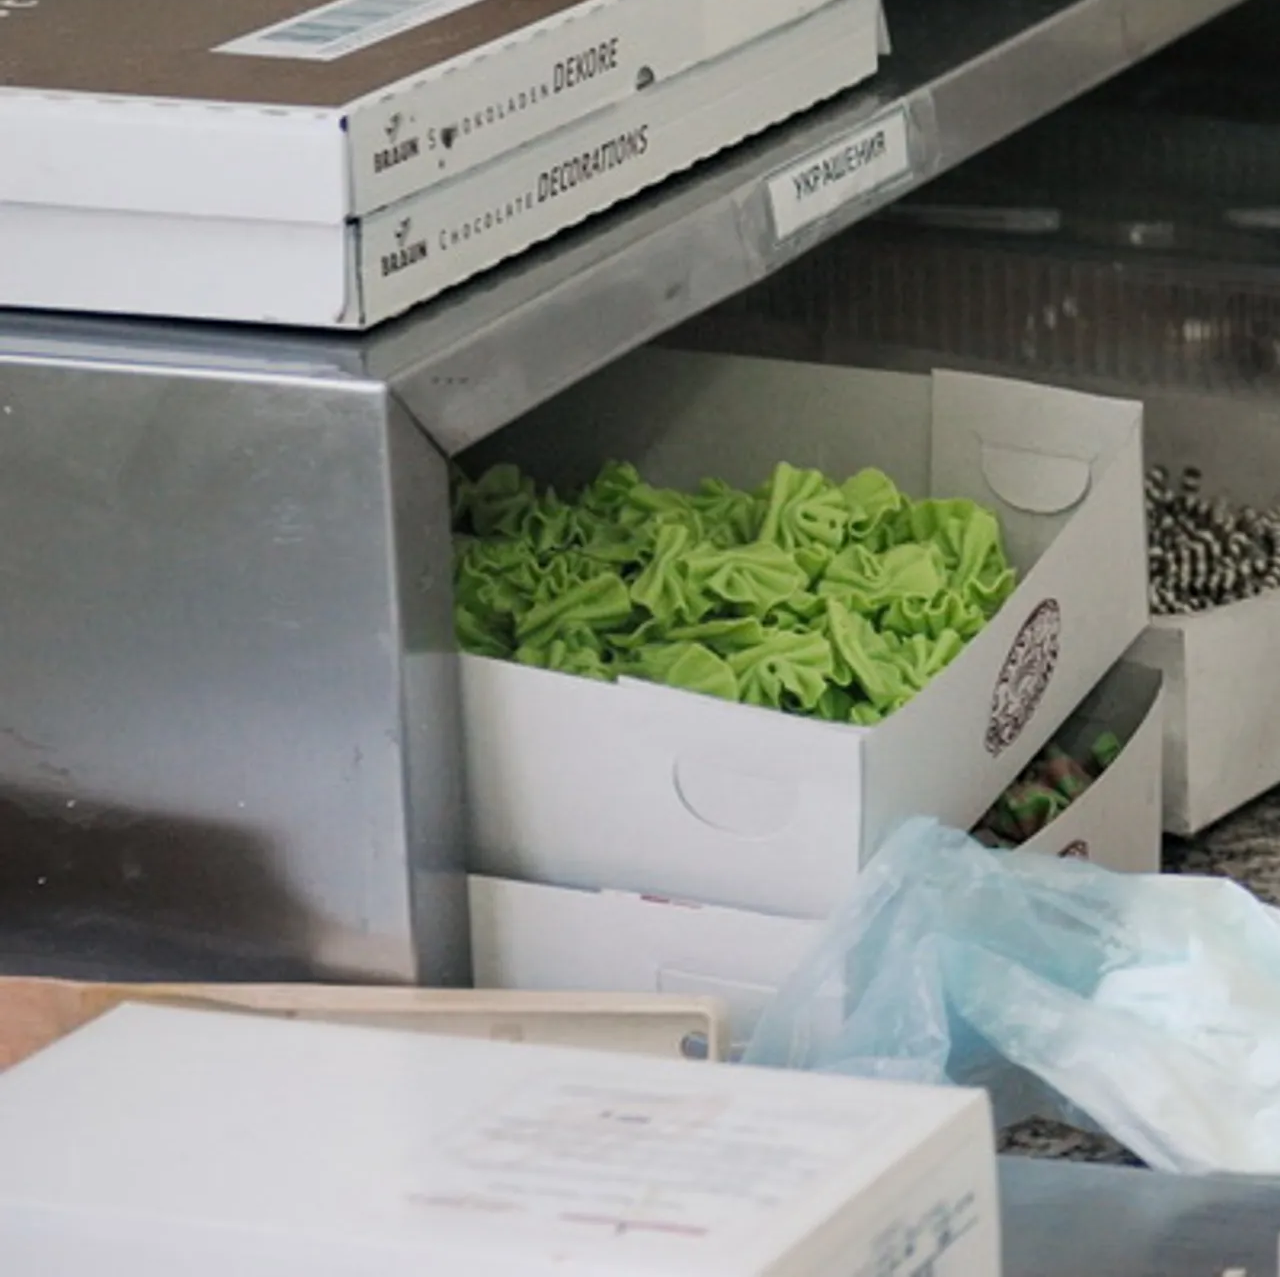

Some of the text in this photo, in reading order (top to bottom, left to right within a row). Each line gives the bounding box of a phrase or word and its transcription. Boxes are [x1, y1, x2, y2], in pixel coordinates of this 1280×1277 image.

[373, 37, 619, 173] BRAUN SOKOLADEN DEKORE
[380, 240, 427, 277] BRAUN
[537, 123, 650, 203] DECORATIONS
